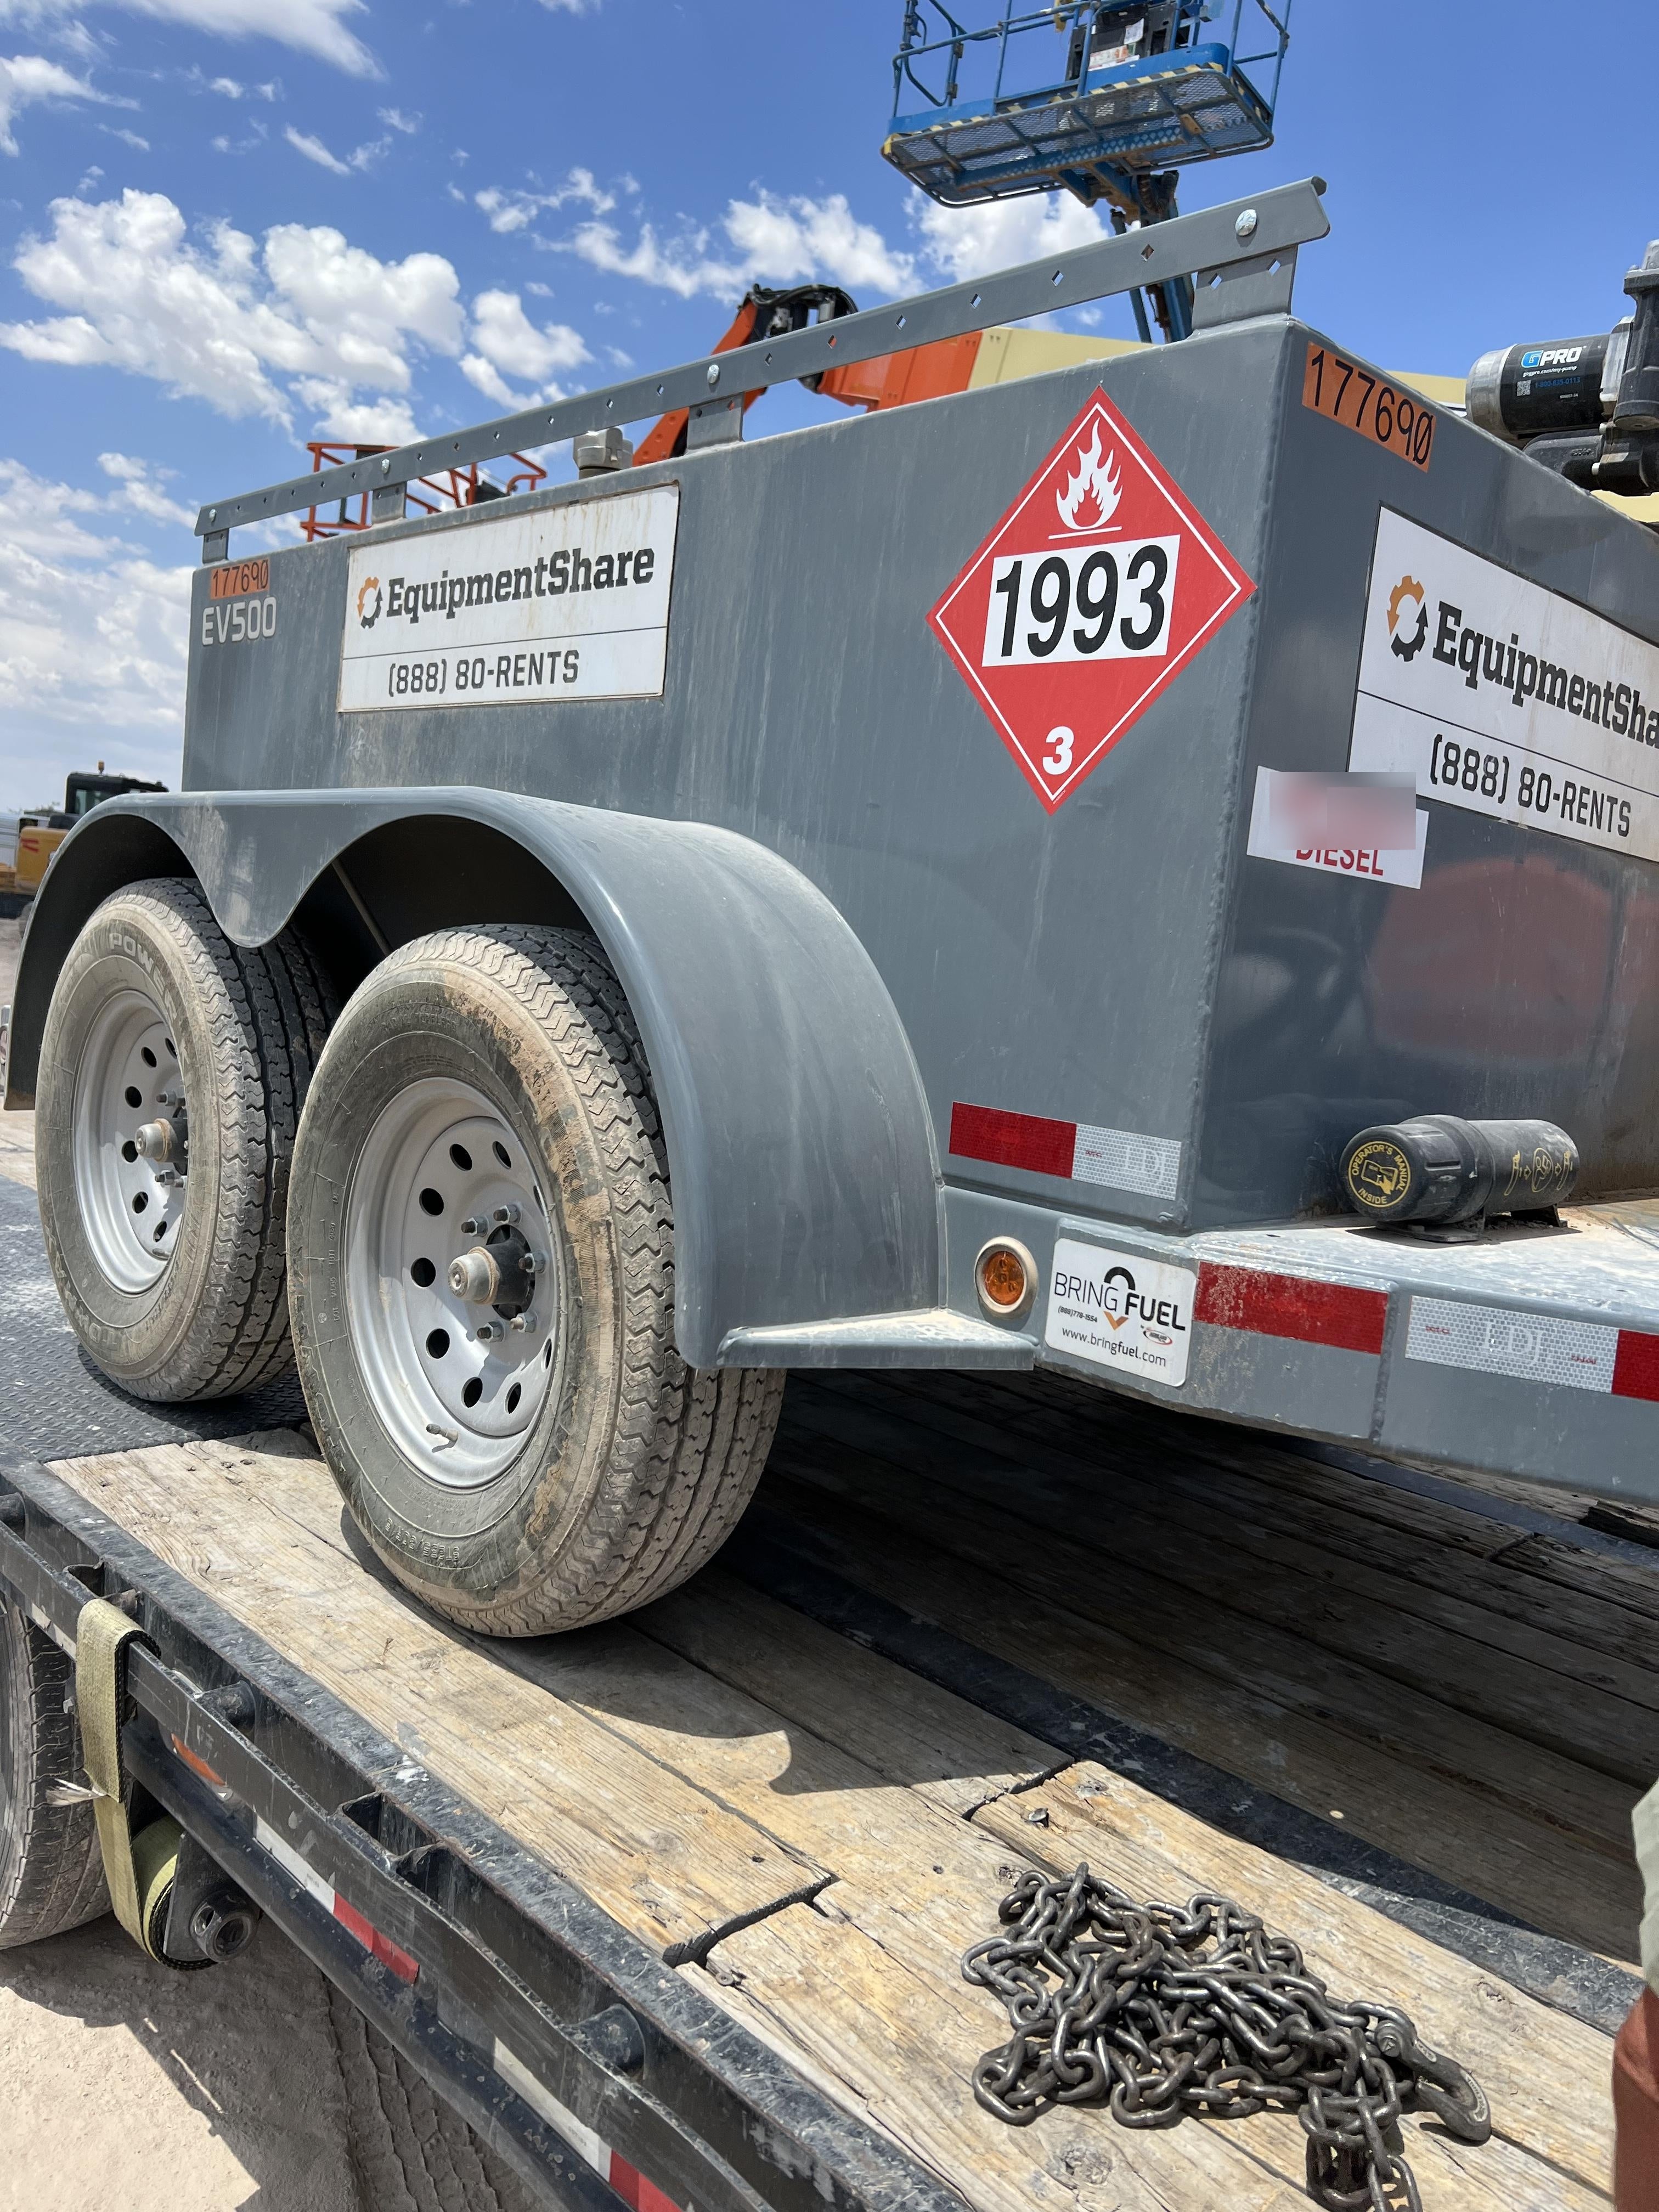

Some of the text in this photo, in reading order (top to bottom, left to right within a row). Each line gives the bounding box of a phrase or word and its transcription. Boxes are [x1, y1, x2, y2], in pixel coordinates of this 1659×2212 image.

[1521, 347, 1583, 368] GPRO
[1311, 349, 1436, 466] 177690
[212, 561, 269, 597] 177690
[386, 548, 654, 620] EquipmentShare
[995, 545, 1168, 657] 1993
[202, 596, 277, 646] EV500
[388, 650, 579, 698] (888) 80-RENTS
[1042, 726, 1075, 775] 3
[1430, 733, 1632, 838] (888) 80-RENTS
[1352, 1144, 1409, 1192] OPERATOR'S MANUAL
[1358, 1188, 1387, 1205] INSIDE
[1054, 1272, 1186, 1331] BRING FUEL
[1062, 1327, 1166, 1367] www.bringfuel.com
